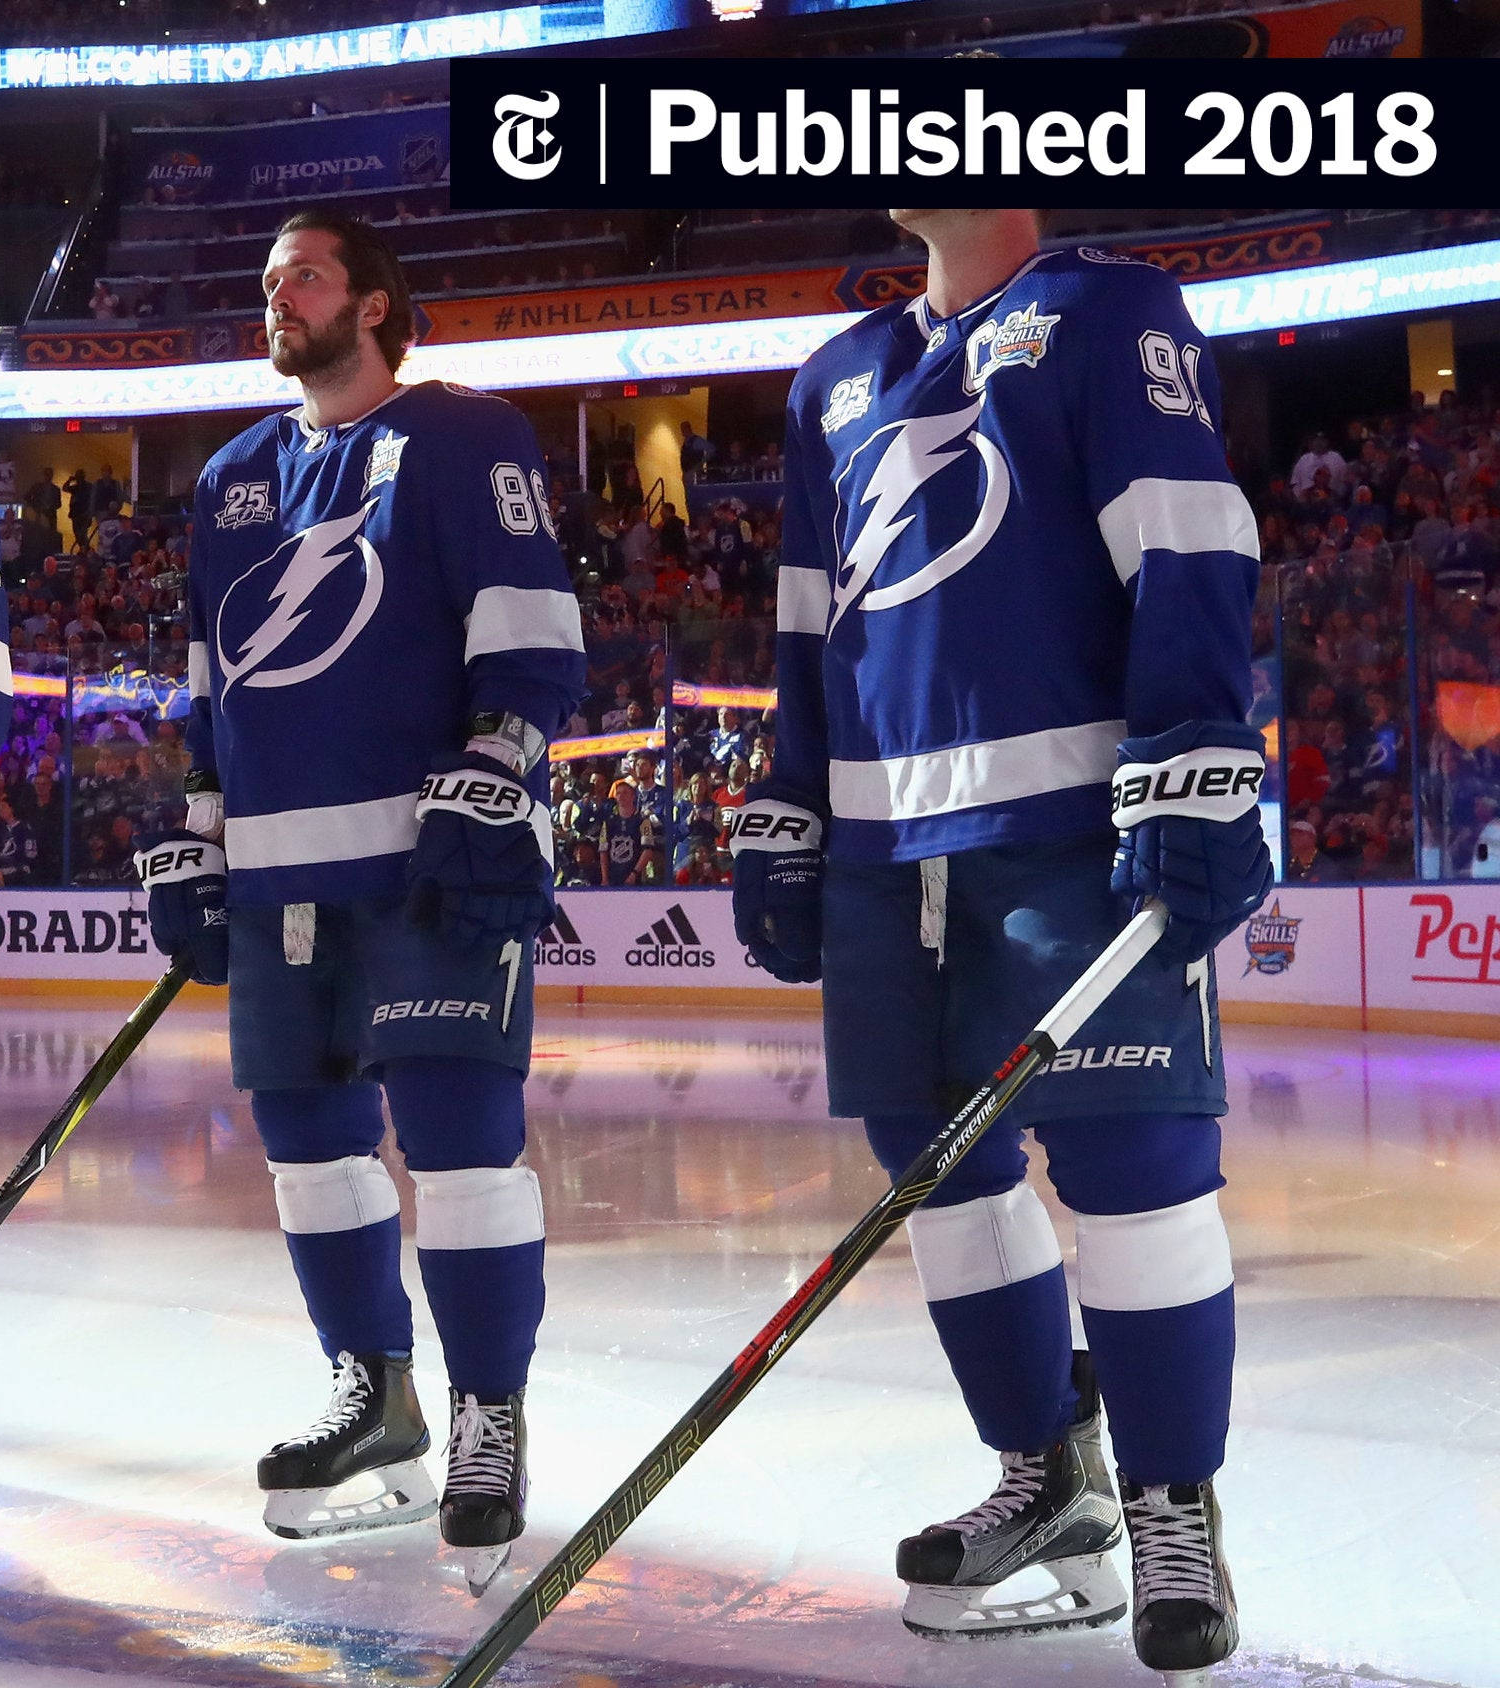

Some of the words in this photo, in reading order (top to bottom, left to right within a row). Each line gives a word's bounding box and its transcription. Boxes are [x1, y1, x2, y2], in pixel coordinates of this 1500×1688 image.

[5, 48, 191, 84] WELCOME
[200, 48, 252, 78] TO
[259, 31, 392, 75] AMALIE
[400, 14, 531, 58] ARENA
[277, 155, 385, 181] HONDA
[493, 287, 770, 332] #NHLALLSTAR
[997, 325, 1046, 348] SKILLS
[829, 373, 874, 411] 25
[224, 481, 270, 514] 25
[1249, 924, 1298, 943] SKILLS
[1409, 894, 1500, 980] Pep
[625, 943, 715, 967] adidas
[371, 999, 491, 1027] BAUER
[935, 1093, 998, 1178] SUPREME
[766, 1330, 789, 1361] MPK
[533, 1417, 701, 1626] BAUER
